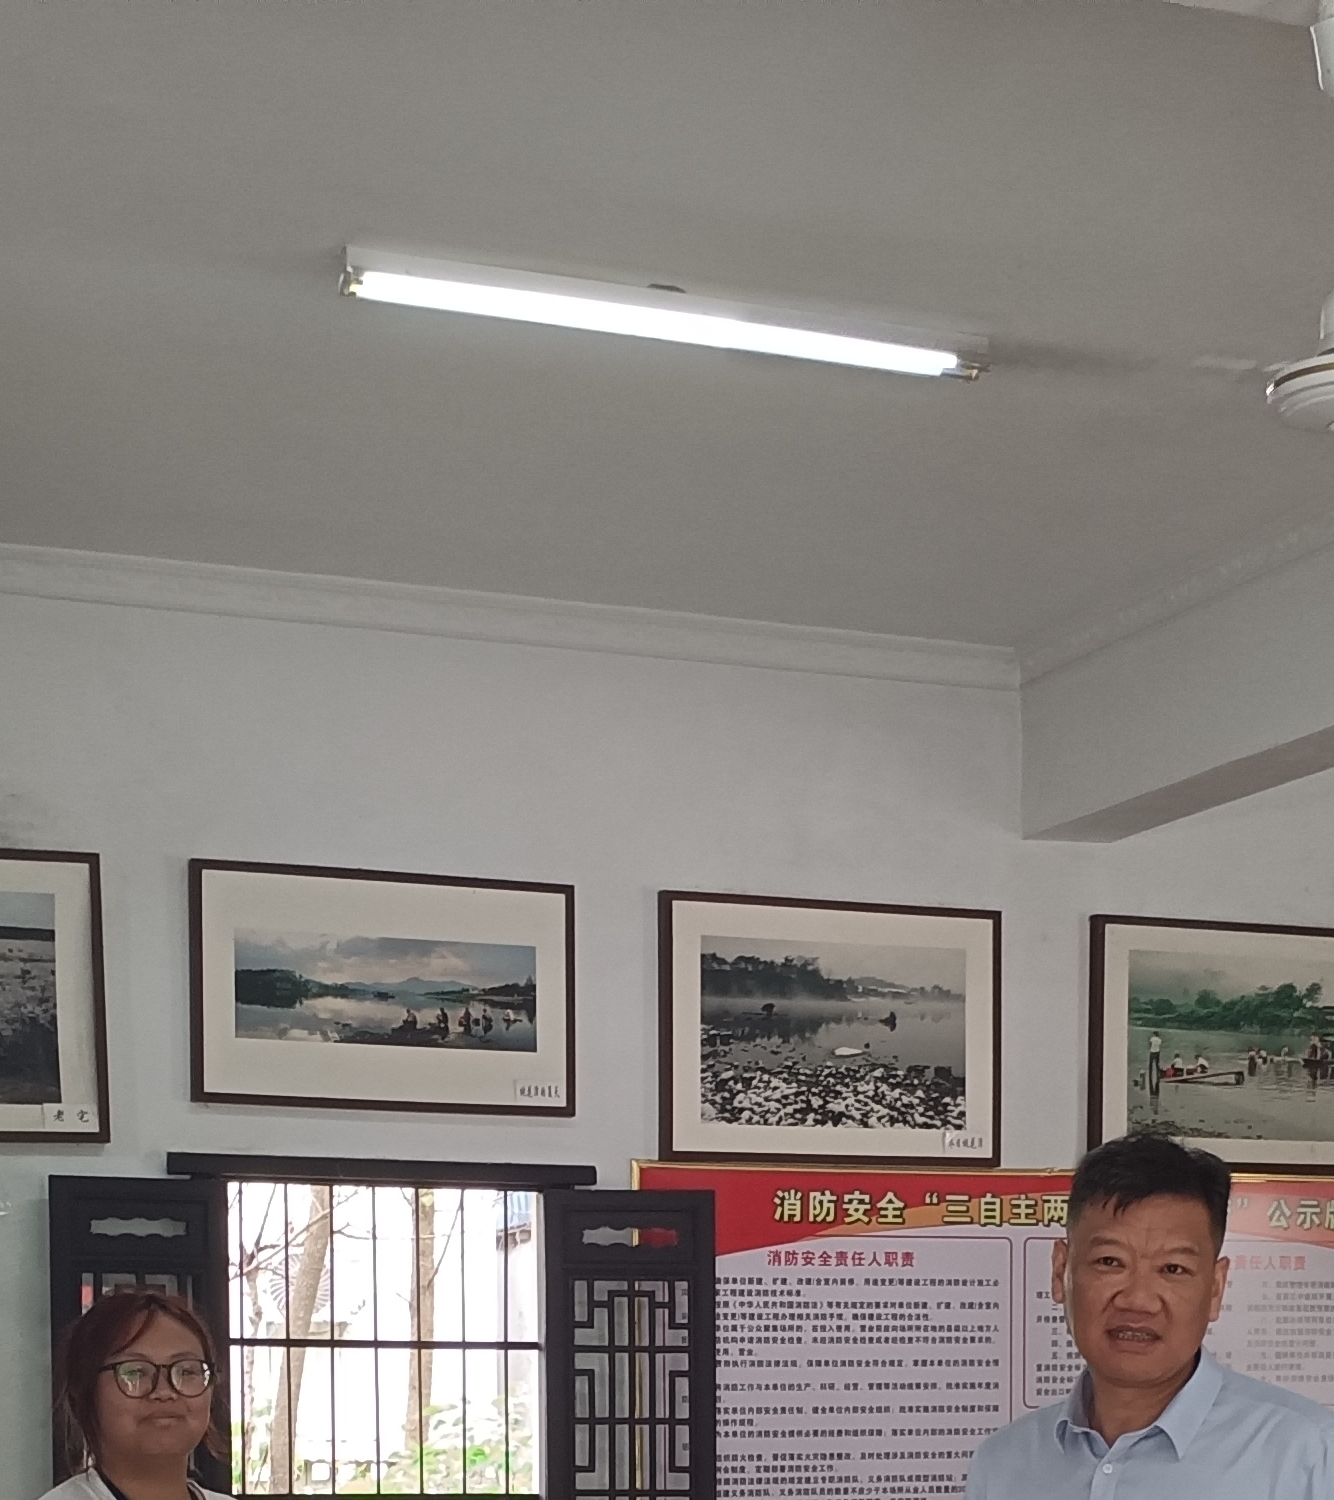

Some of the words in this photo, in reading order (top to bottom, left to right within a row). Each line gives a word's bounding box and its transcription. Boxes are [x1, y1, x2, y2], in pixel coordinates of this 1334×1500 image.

[767, 1249, 916, 1269] 消防安全责任人职责
